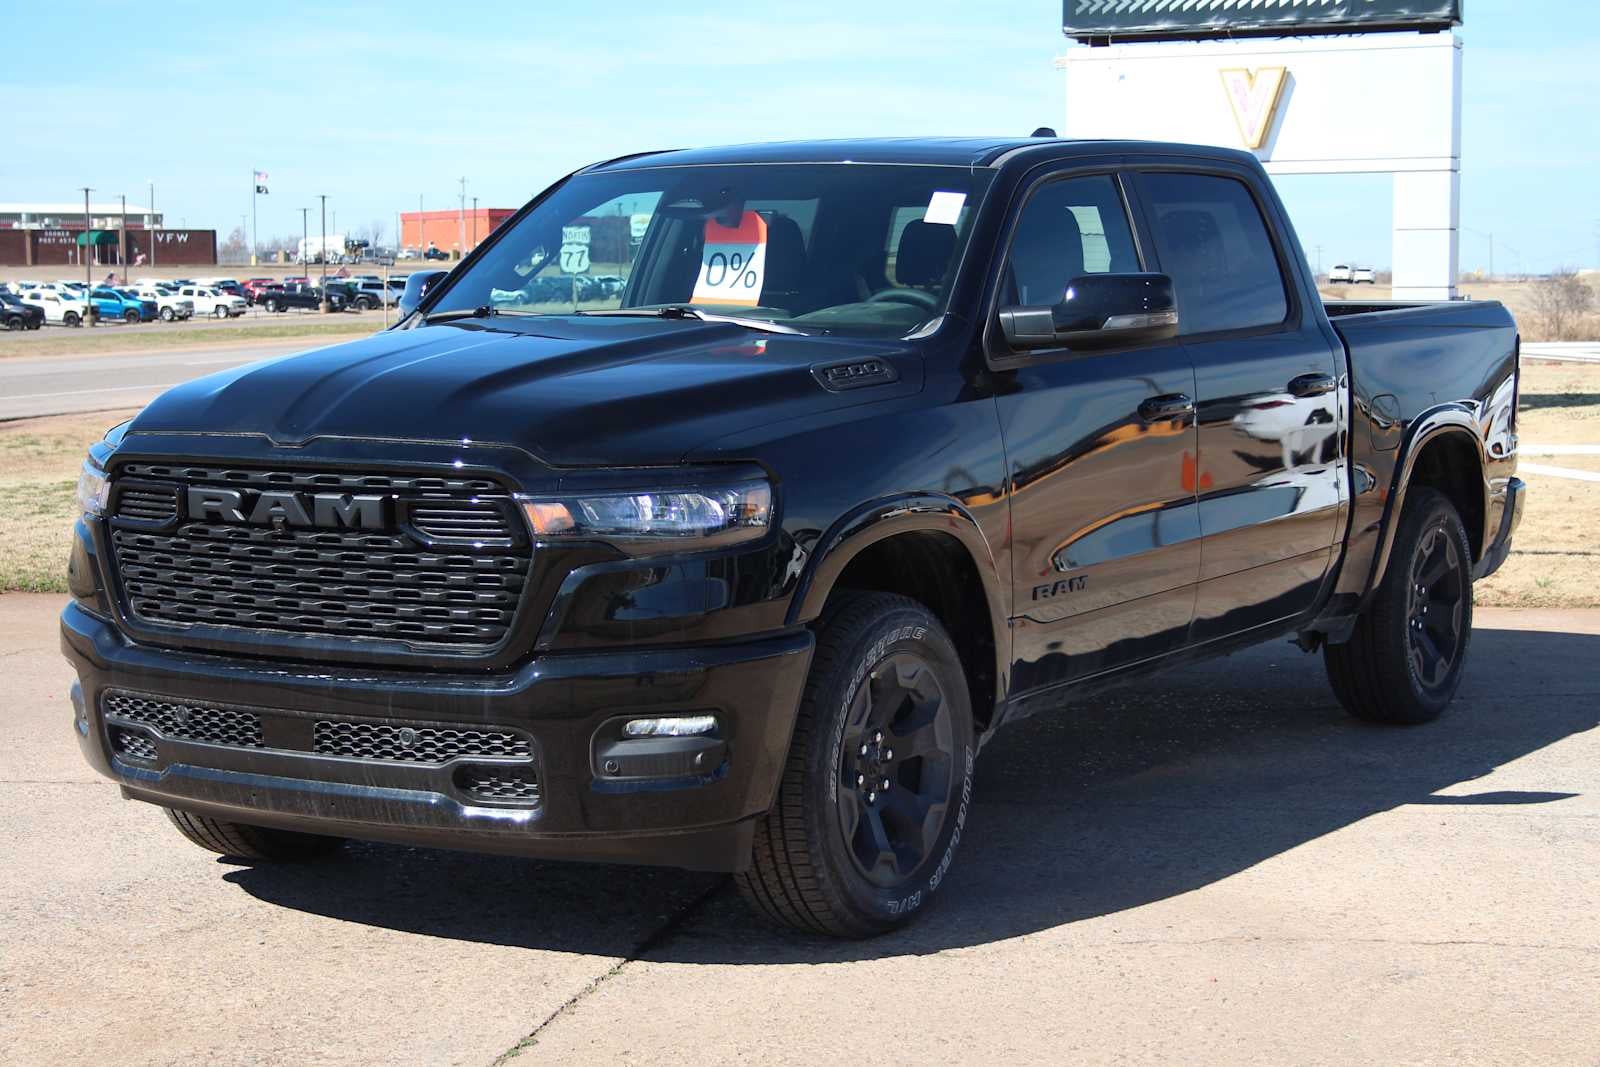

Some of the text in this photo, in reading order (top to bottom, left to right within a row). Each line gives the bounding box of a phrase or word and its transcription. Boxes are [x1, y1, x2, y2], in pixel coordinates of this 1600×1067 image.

[156, 233, 189, 243] VFW
[563, 231, 588, 241] NORTH
[563, 250, 586, 268] 77
[706, 252, 757, 288] 0%
[823, 360, 883, 382] 1500
[187, 484, 390, 529] RAM
[1032, 575, 1089, 601] RAM
